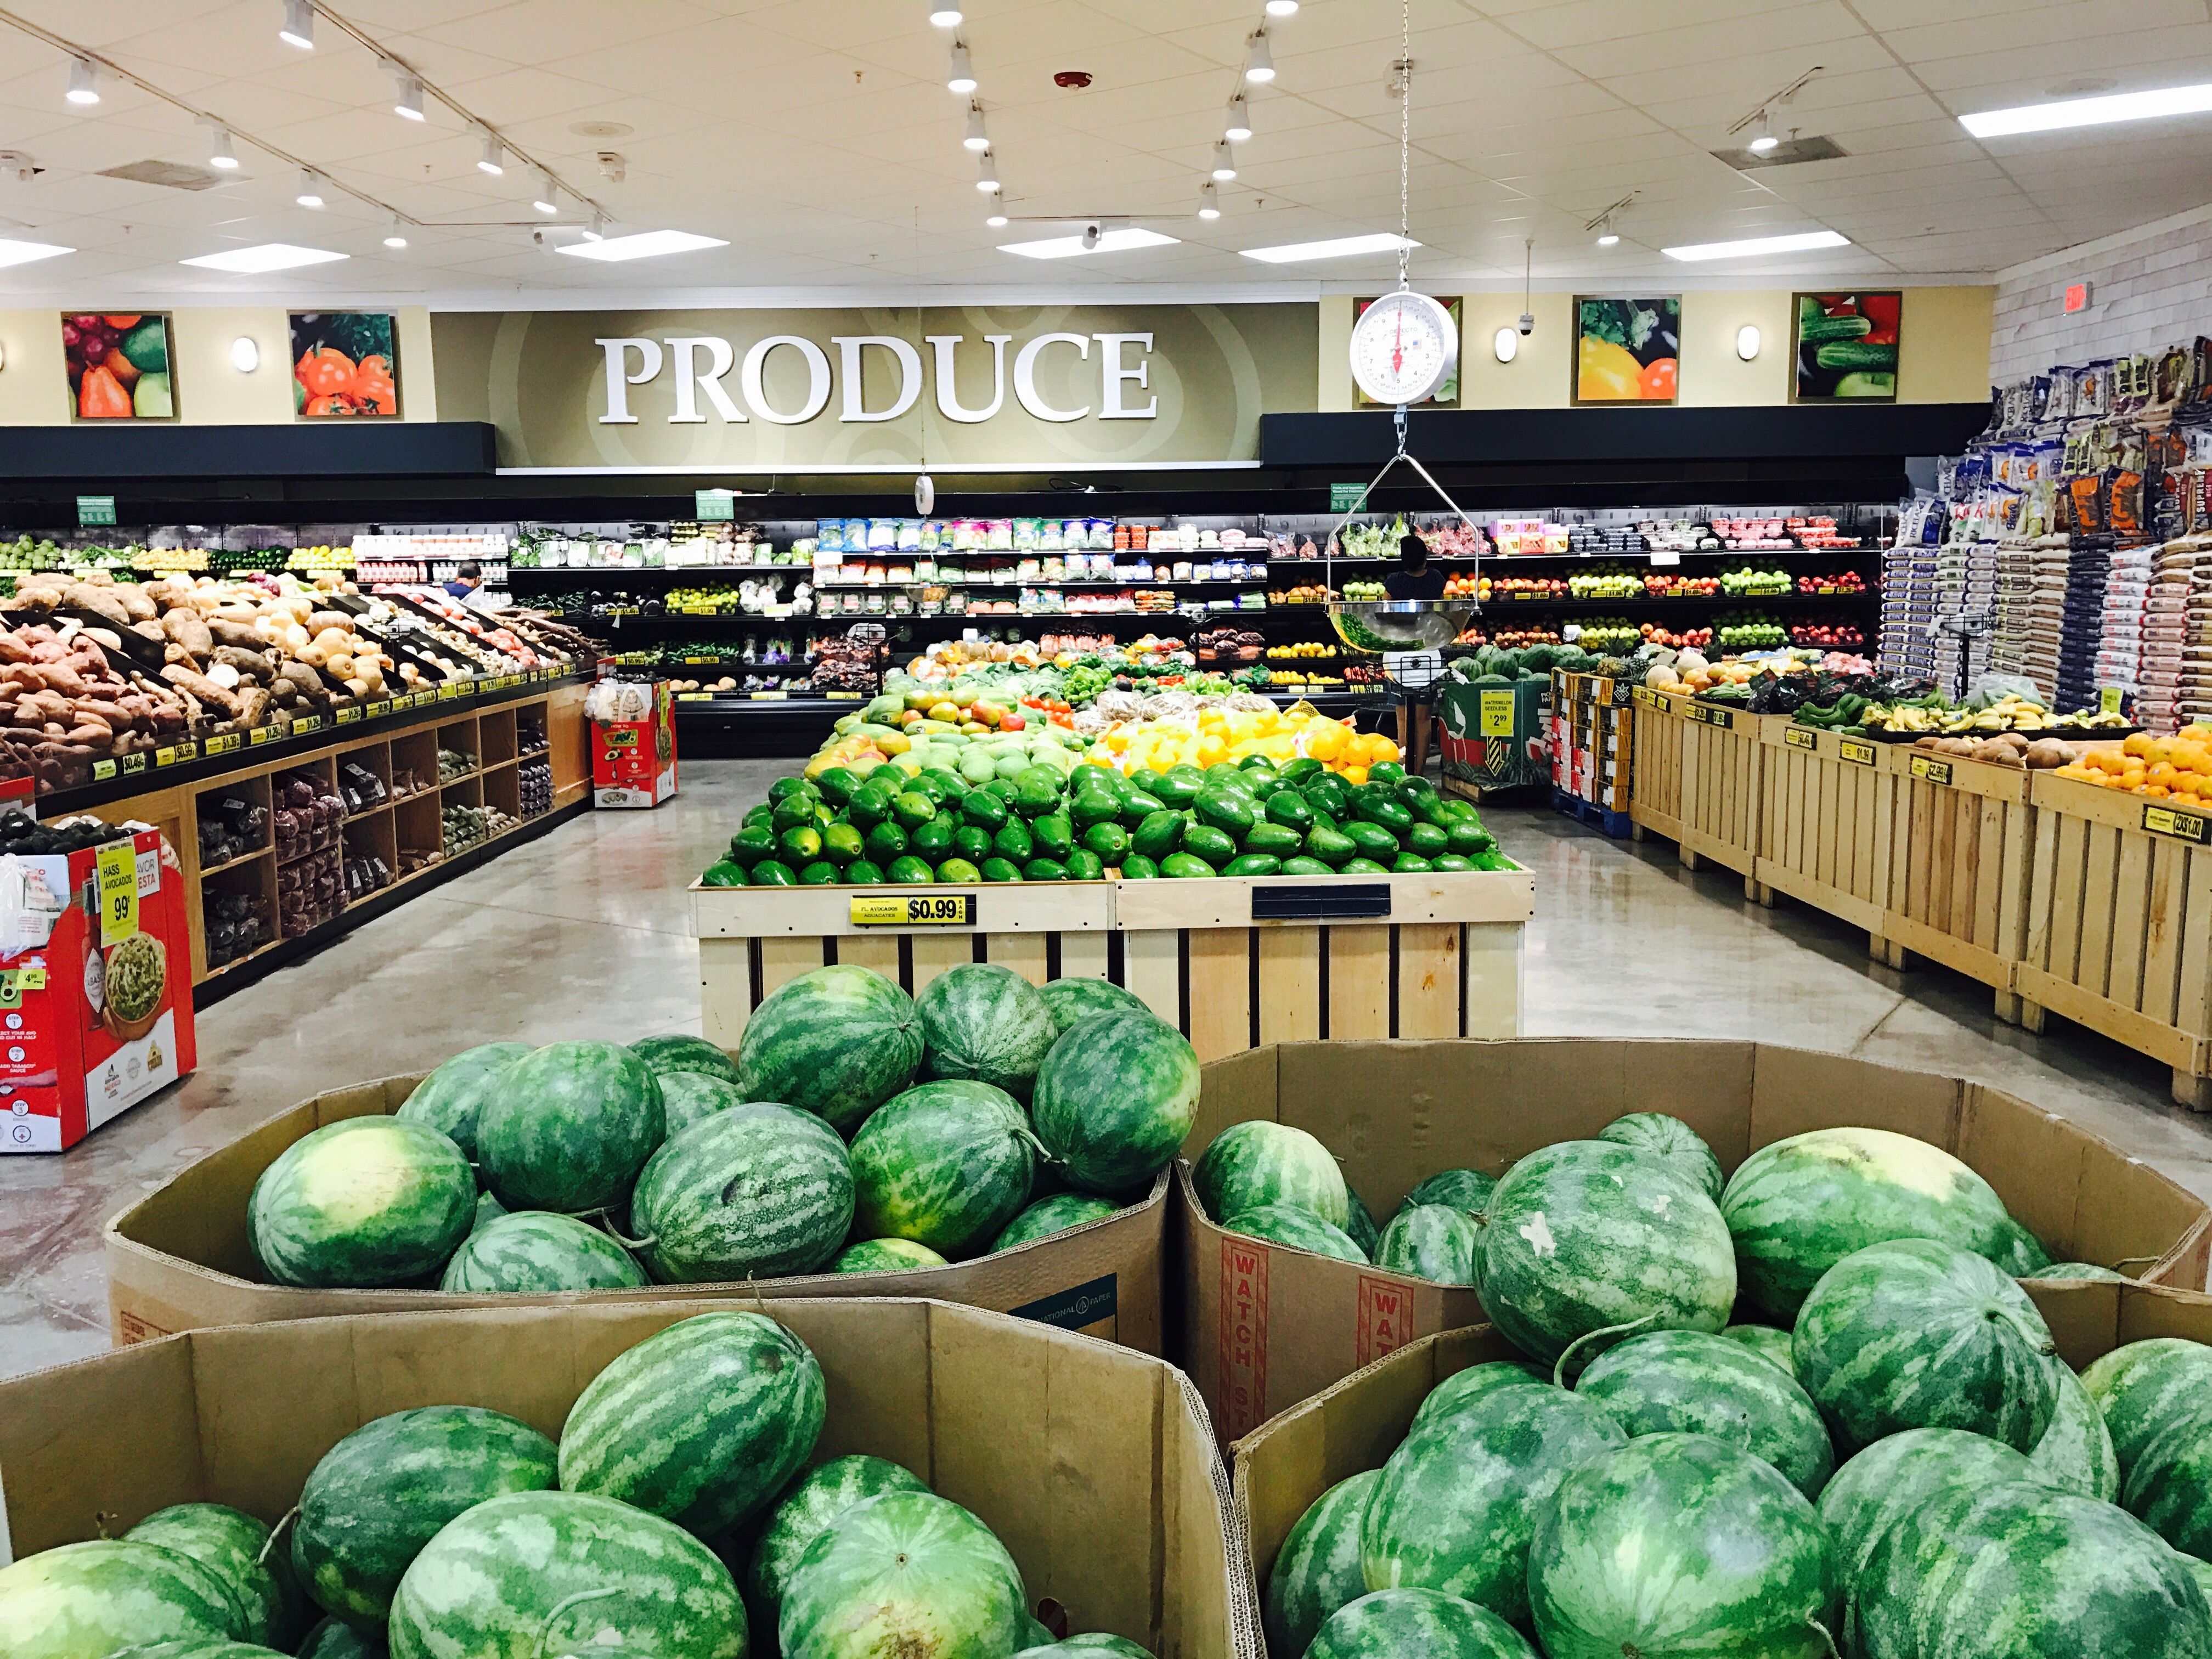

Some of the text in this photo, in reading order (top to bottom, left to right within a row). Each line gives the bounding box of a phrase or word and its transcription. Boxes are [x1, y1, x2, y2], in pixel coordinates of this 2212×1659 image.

[595, 332, 1158, 425] PRODUCE
[103, 864, 120, 878] HASS
[105, 874, 132, 891] AVOCADOS
[909, 899, 957, 921] $0.99
[1090, 1292, 1111, 1305] PAPER
[1235, 1254, 1255, 1368] WATCH
